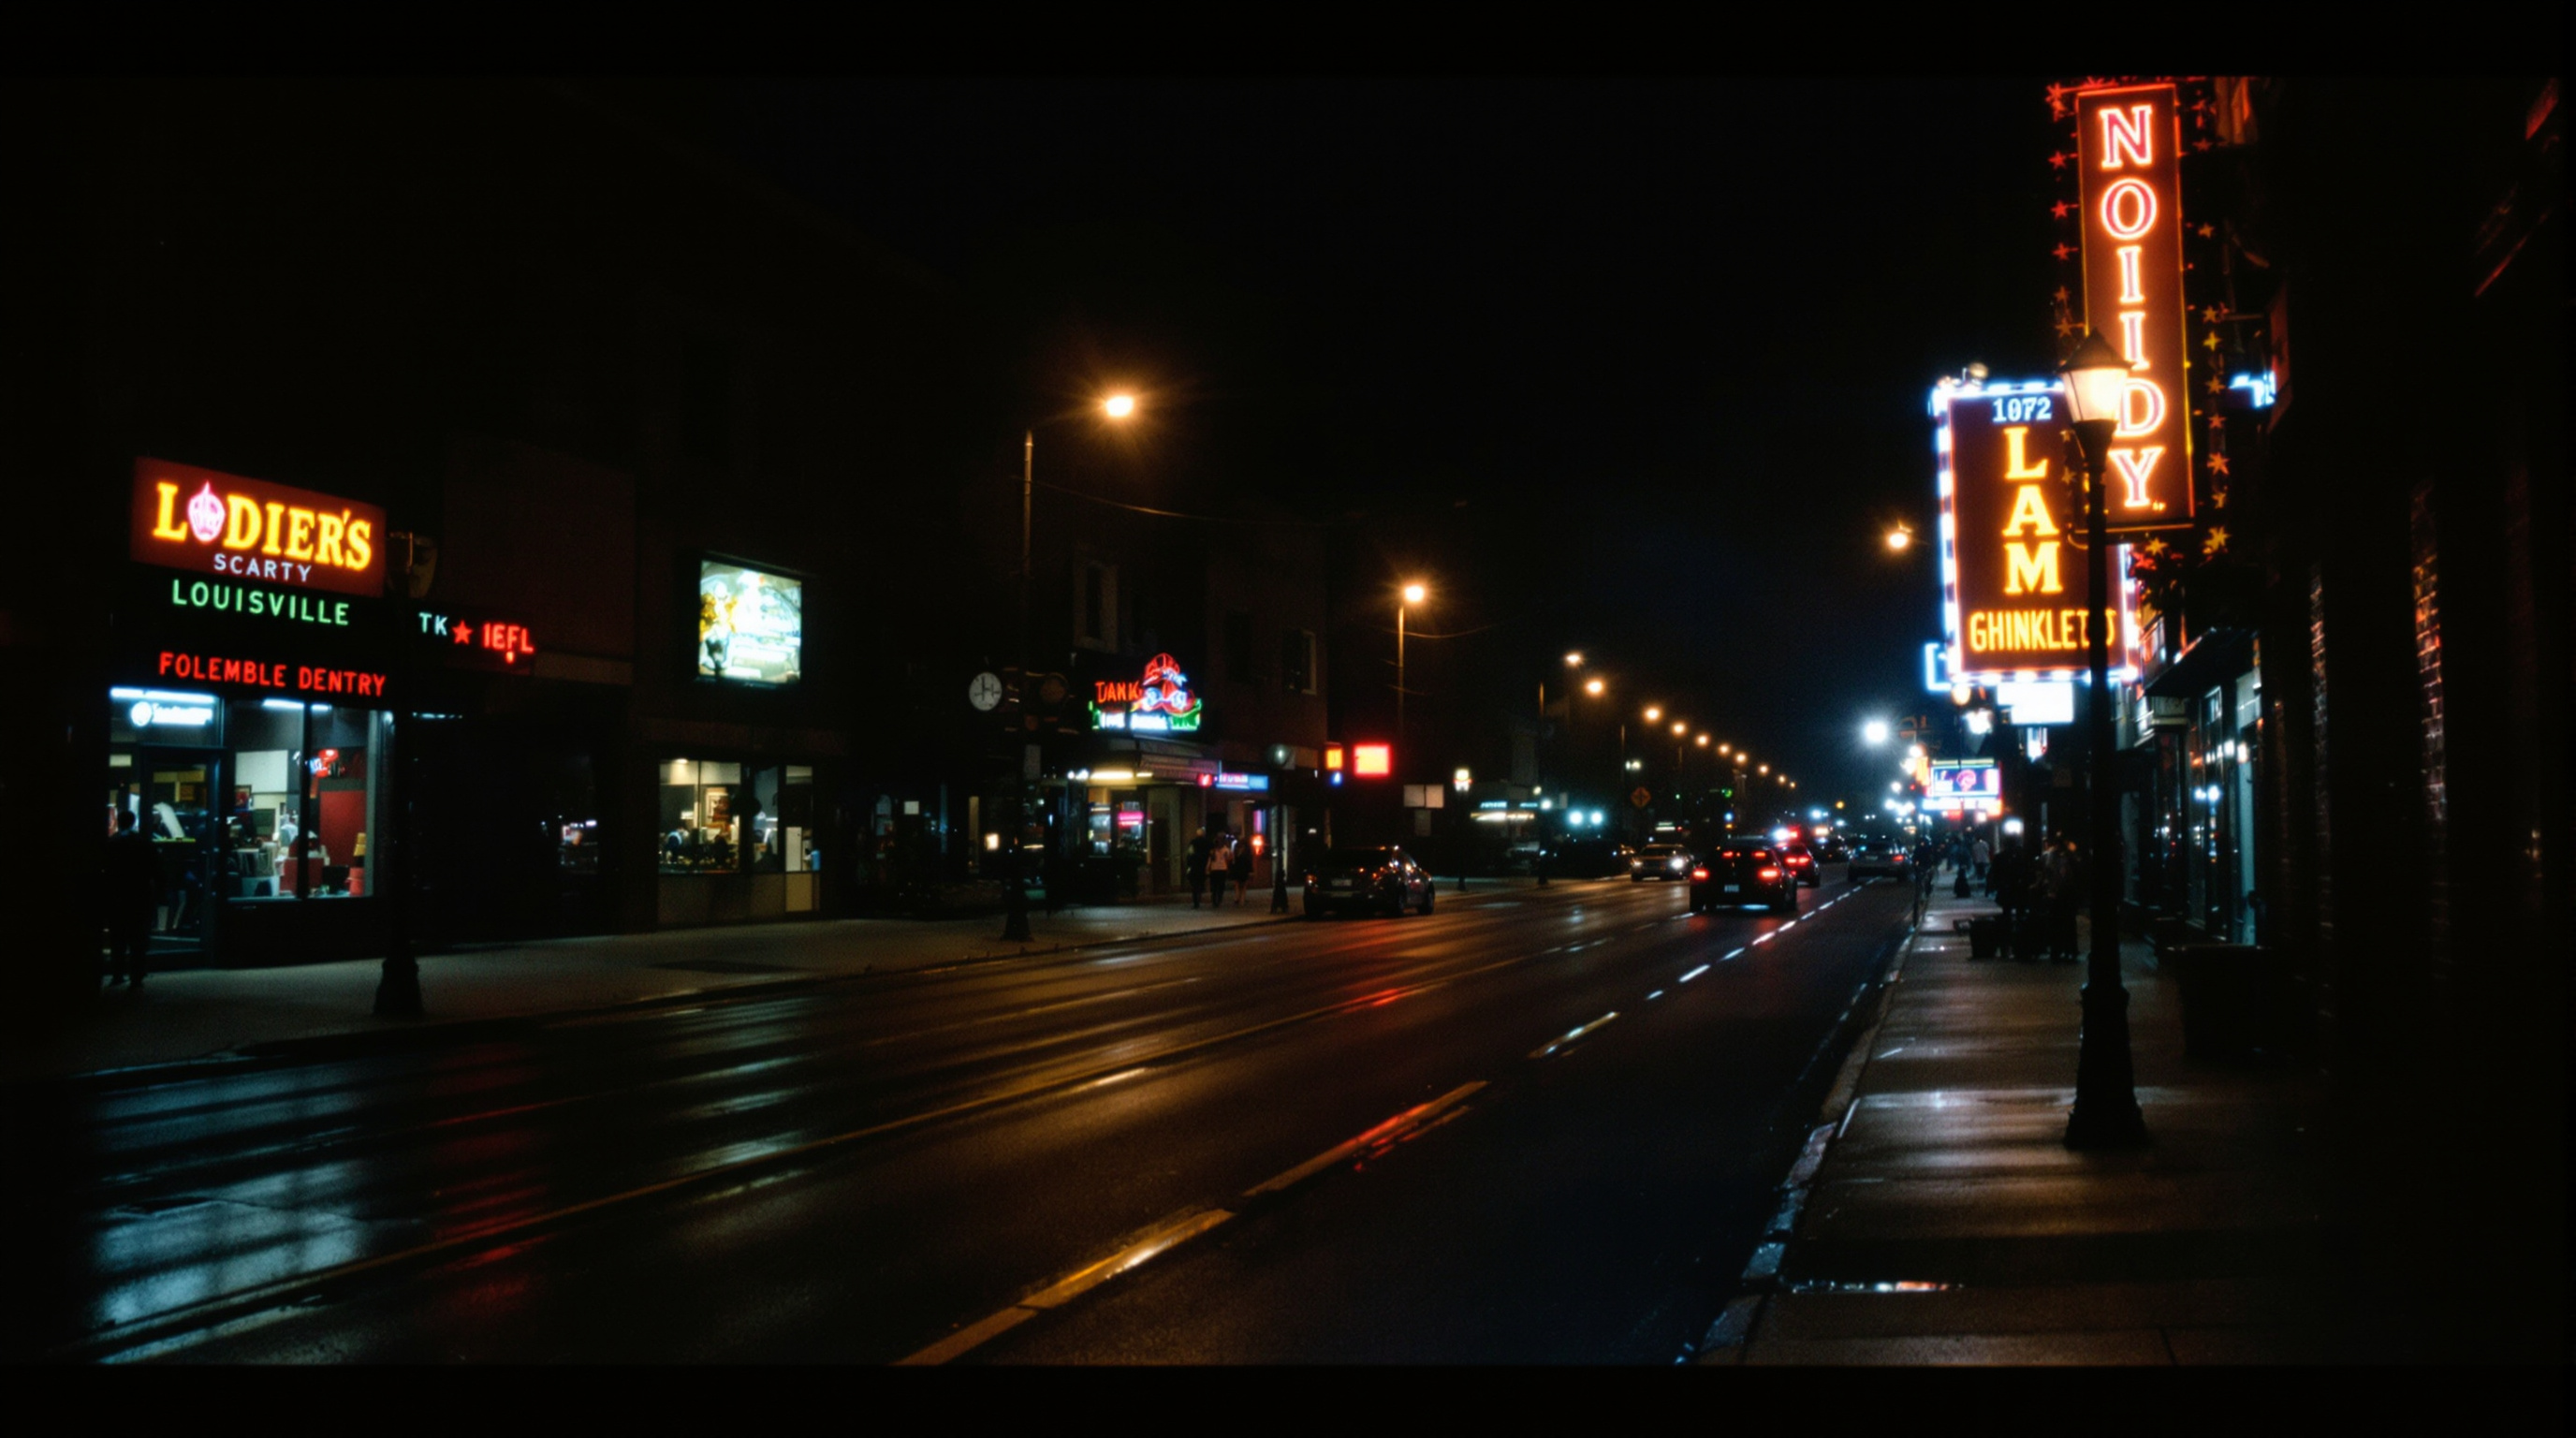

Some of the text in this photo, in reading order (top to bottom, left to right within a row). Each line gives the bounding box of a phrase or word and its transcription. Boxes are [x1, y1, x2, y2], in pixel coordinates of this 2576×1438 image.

[2002, 426, 2063, 594] LAM
[213, 552, 312, 582] SCARTY
[172, 579, 349, 625] LOUISVILLE
[159, 652, 386, 697] FOLEMBLE DENTRY
